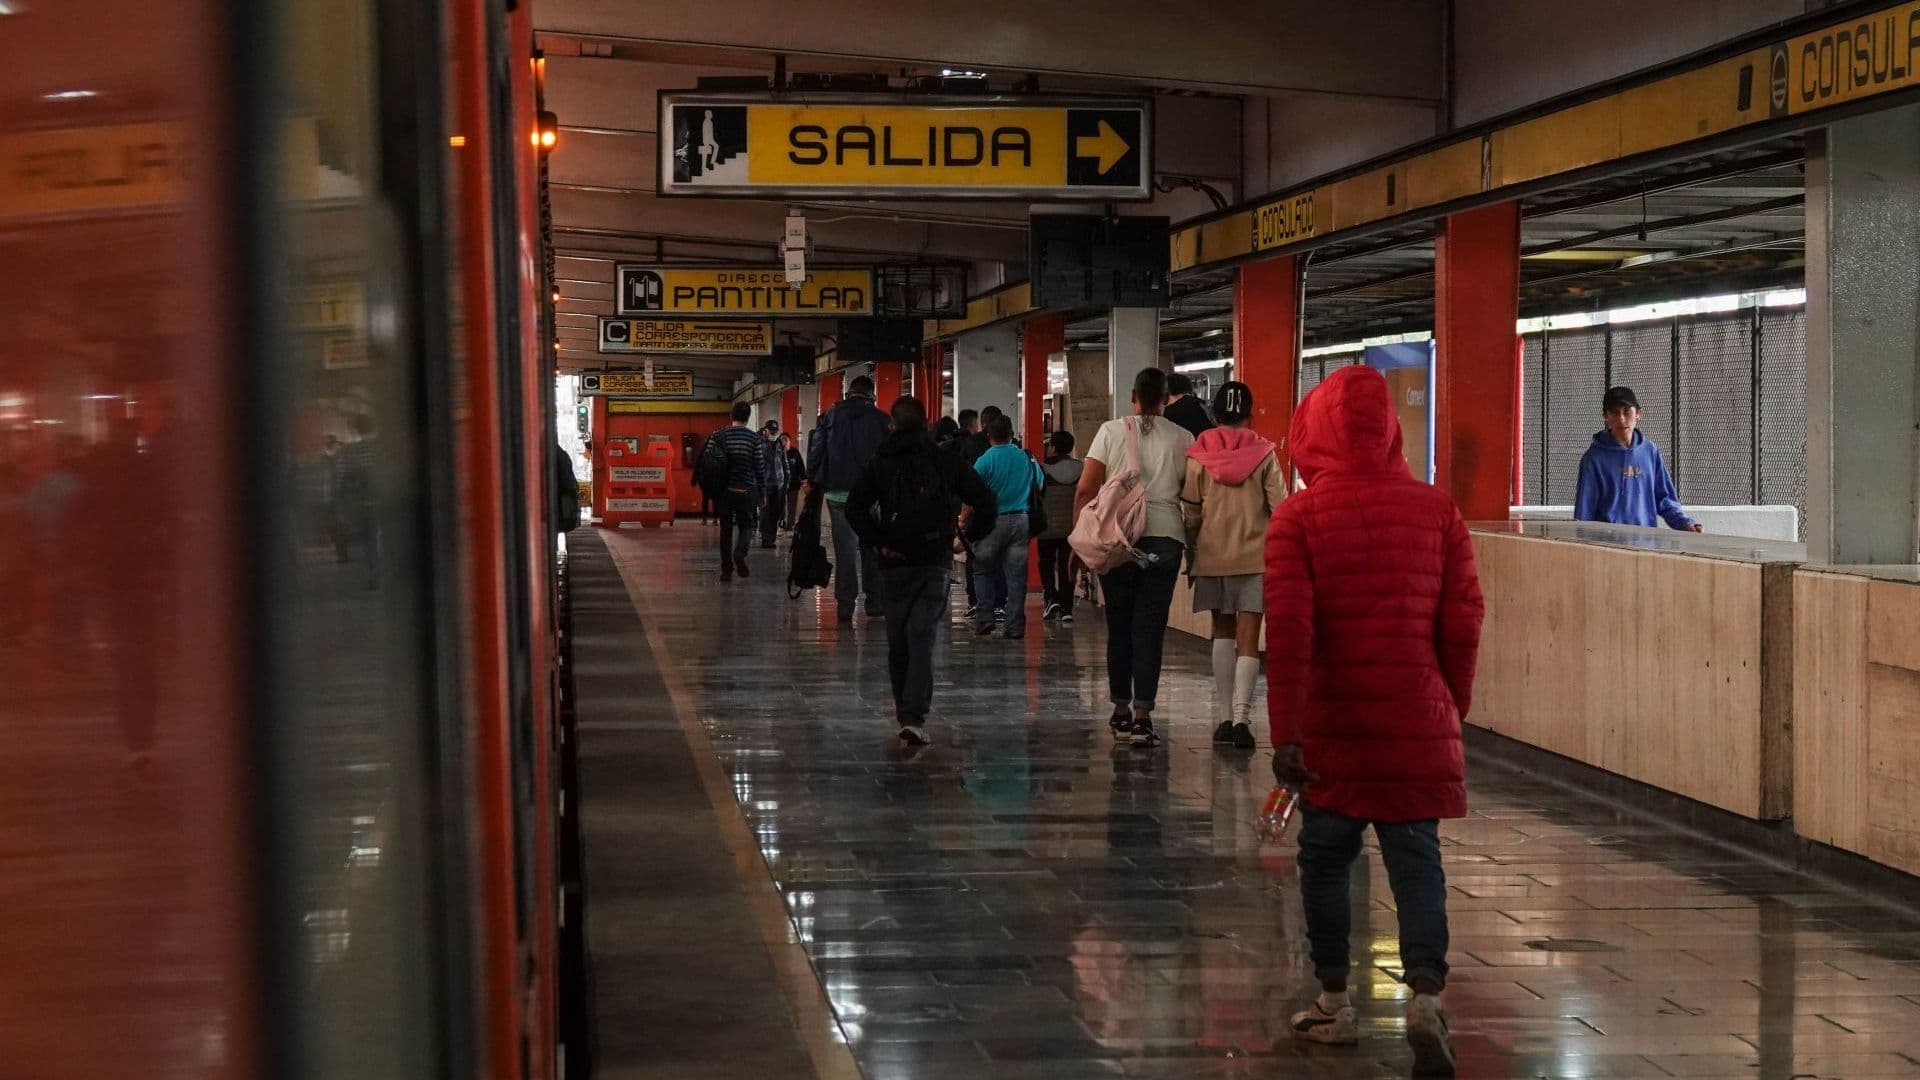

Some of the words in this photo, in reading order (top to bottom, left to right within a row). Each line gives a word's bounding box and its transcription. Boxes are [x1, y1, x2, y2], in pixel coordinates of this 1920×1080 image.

[788, 124, 1031, 167] SALIDA
[1263, 195, 1314, 245] CONSULADO
[718, 273, 814, 284] DIRECCN
[673, 286, 864, 309] PANTITLAN
[606, 321, 627, 342] C
[636, 322, 685, 332] SALIDA
[635, 331, 764, 343] CORRESPONDENCIA
[583, 375, 598, 389] C
